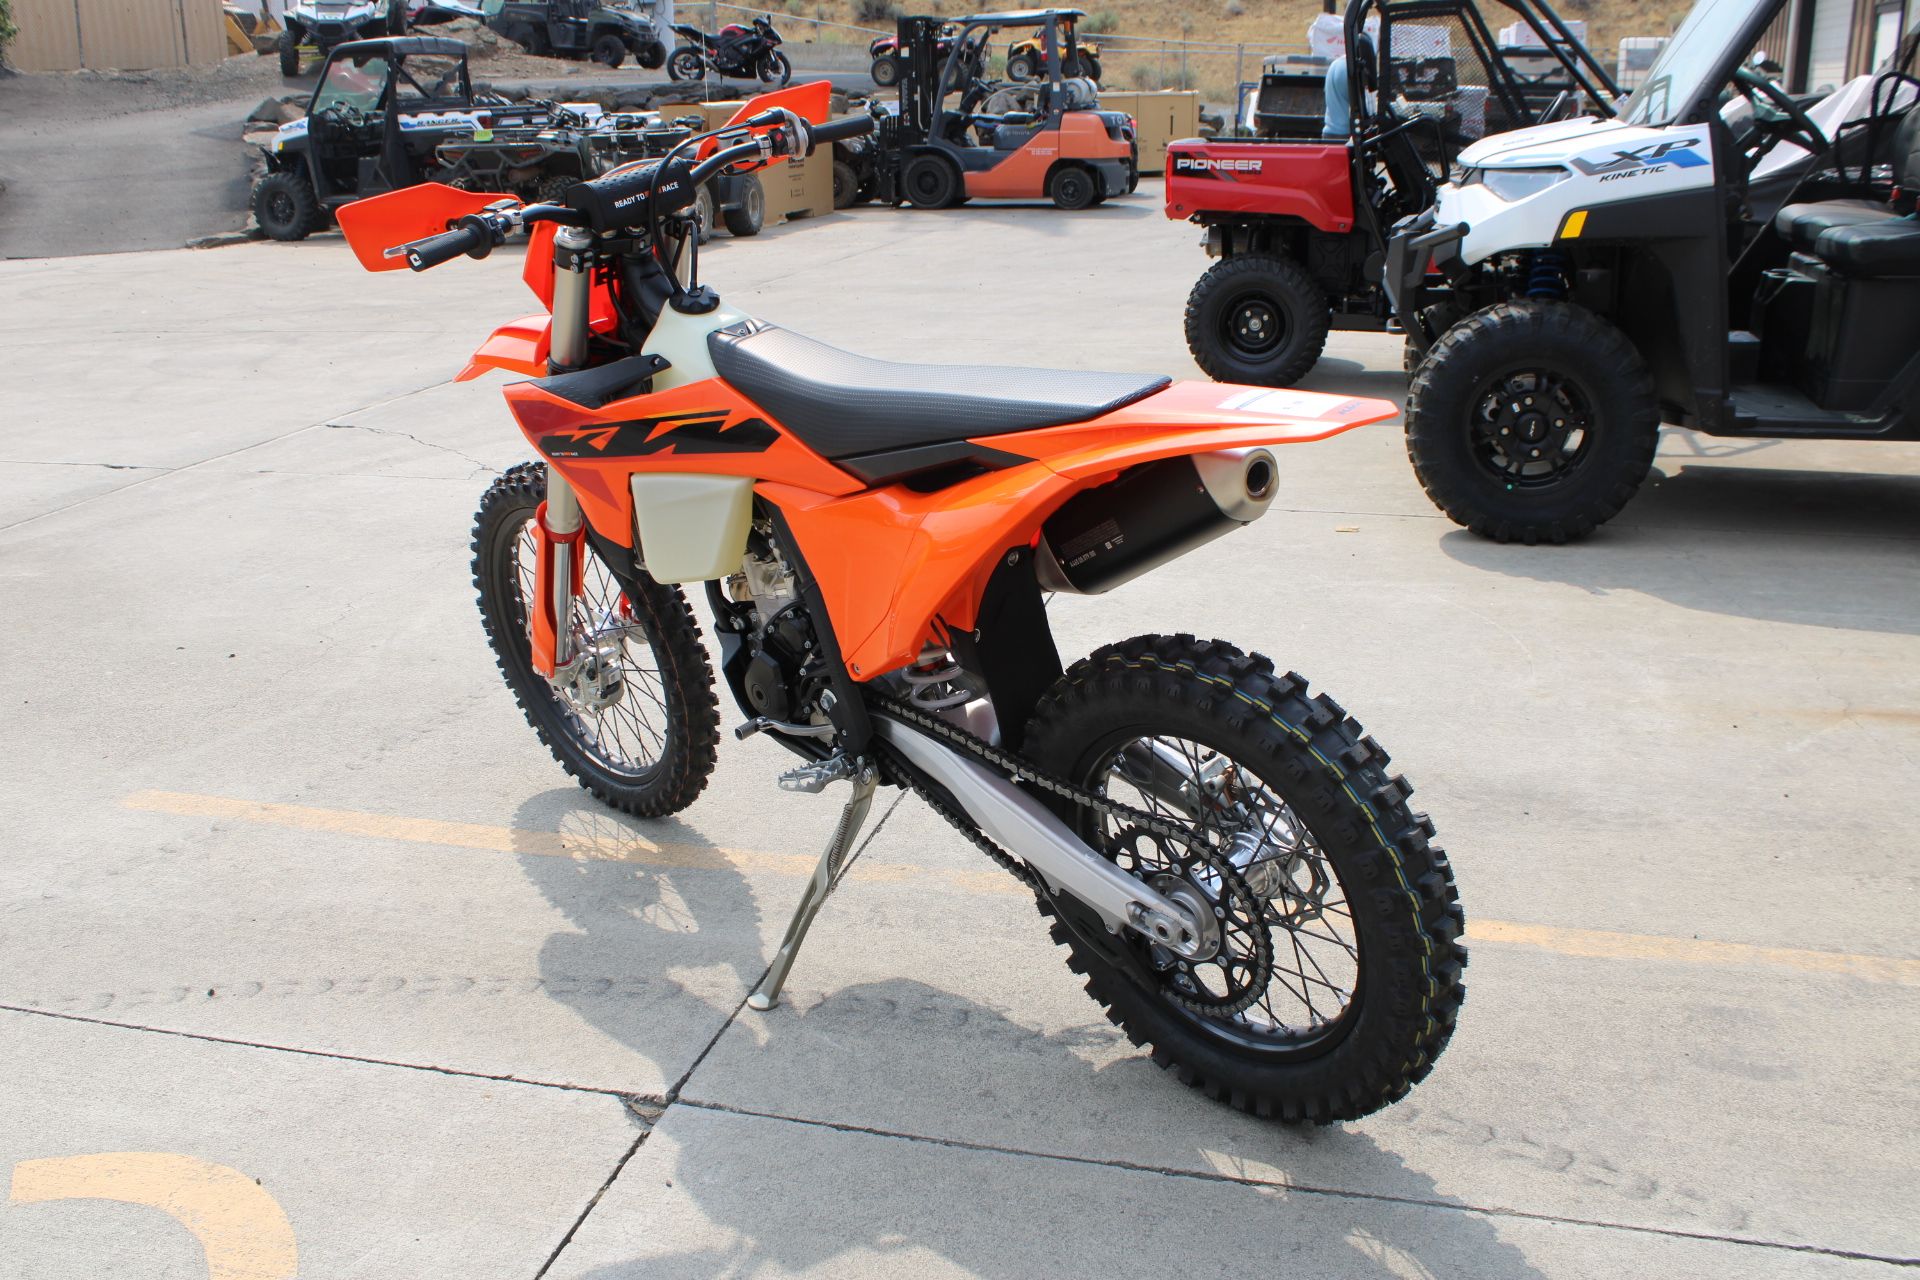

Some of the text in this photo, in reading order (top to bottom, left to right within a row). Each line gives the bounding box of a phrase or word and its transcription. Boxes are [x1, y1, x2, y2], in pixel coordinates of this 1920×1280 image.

[416, 118, 458, 127] RANGER
[1600, 138, 1701, 168] XP
[1176, 159, 1263, 171] PIONEER
[1599, 165, 1668, 182] KINETIC
[614, 181, 679, 208] READY TO RACE
[538, 409, 781, 458] KTM
